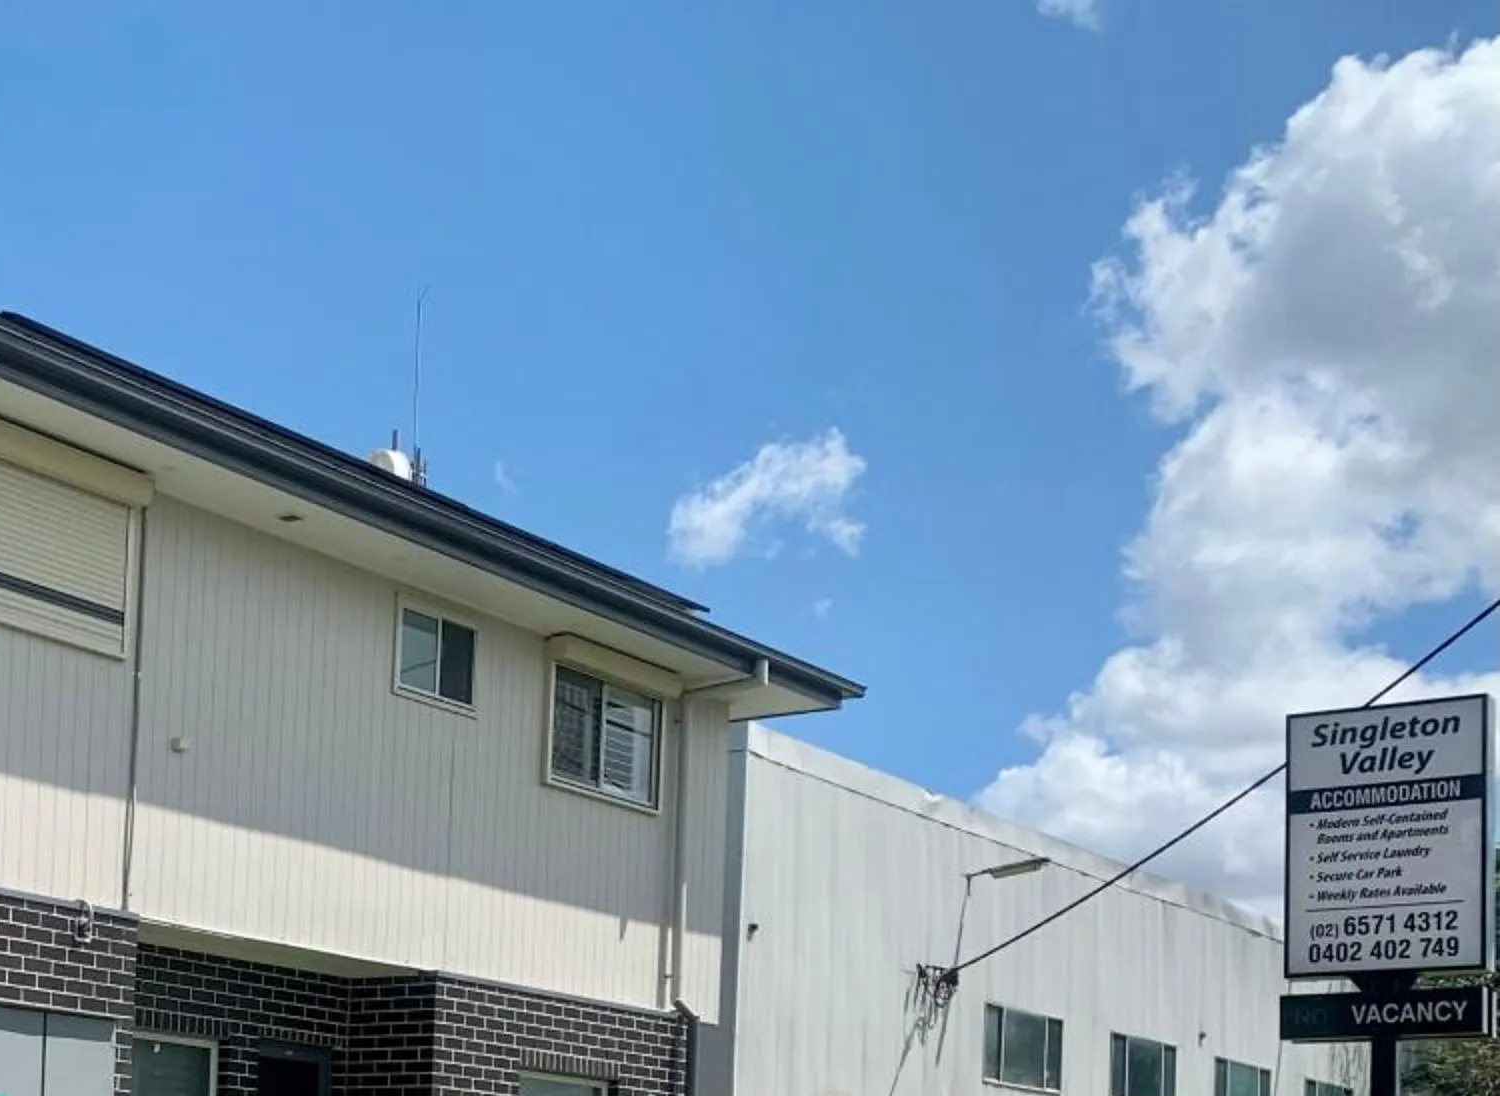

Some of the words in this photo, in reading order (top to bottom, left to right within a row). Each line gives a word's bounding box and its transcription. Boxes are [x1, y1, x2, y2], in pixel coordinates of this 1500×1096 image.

[1310, 715, 1461, 748] Singleton
[1339, 746, 1435, 774] Valley
[1309, 779, 1461, 810] ACCOMMODATION
[1316, 816, 1360, 830] Modern
[1362, 808, 1449, 826] Self-Contained
[1317, 832, 1354, 845] Rooms
[1356, 829, 1379, 842] and
[1379, 825, 1449, 841] Apartments
[1316, 851, 1340, 864] Self
[1340, 849, 1381, 863] Service
[1382, 845, 1431, 859] Laundry
[1316, 870, 1354, 883] Secure
[1355, 868, 1373, 880] Car
[1376, 865, 1402, 879] Park
[1316, 888, 1357, 902] Weekly
[1359, 886, 1392, 900] Rates
[1392, 881, 1447, 898] Available
[1309, 923, 1339, 940] (02)
[1343, 913, 1396, 936] 6571
[1403, 910, 1459, 932] 4312
[1308, 941, 1362, 963] 0402
[1369, 938, 1411, 960] 402
[1419, 936, 1460, 958] 749
[1351, 1000, 1468, 1025] VACANCY
